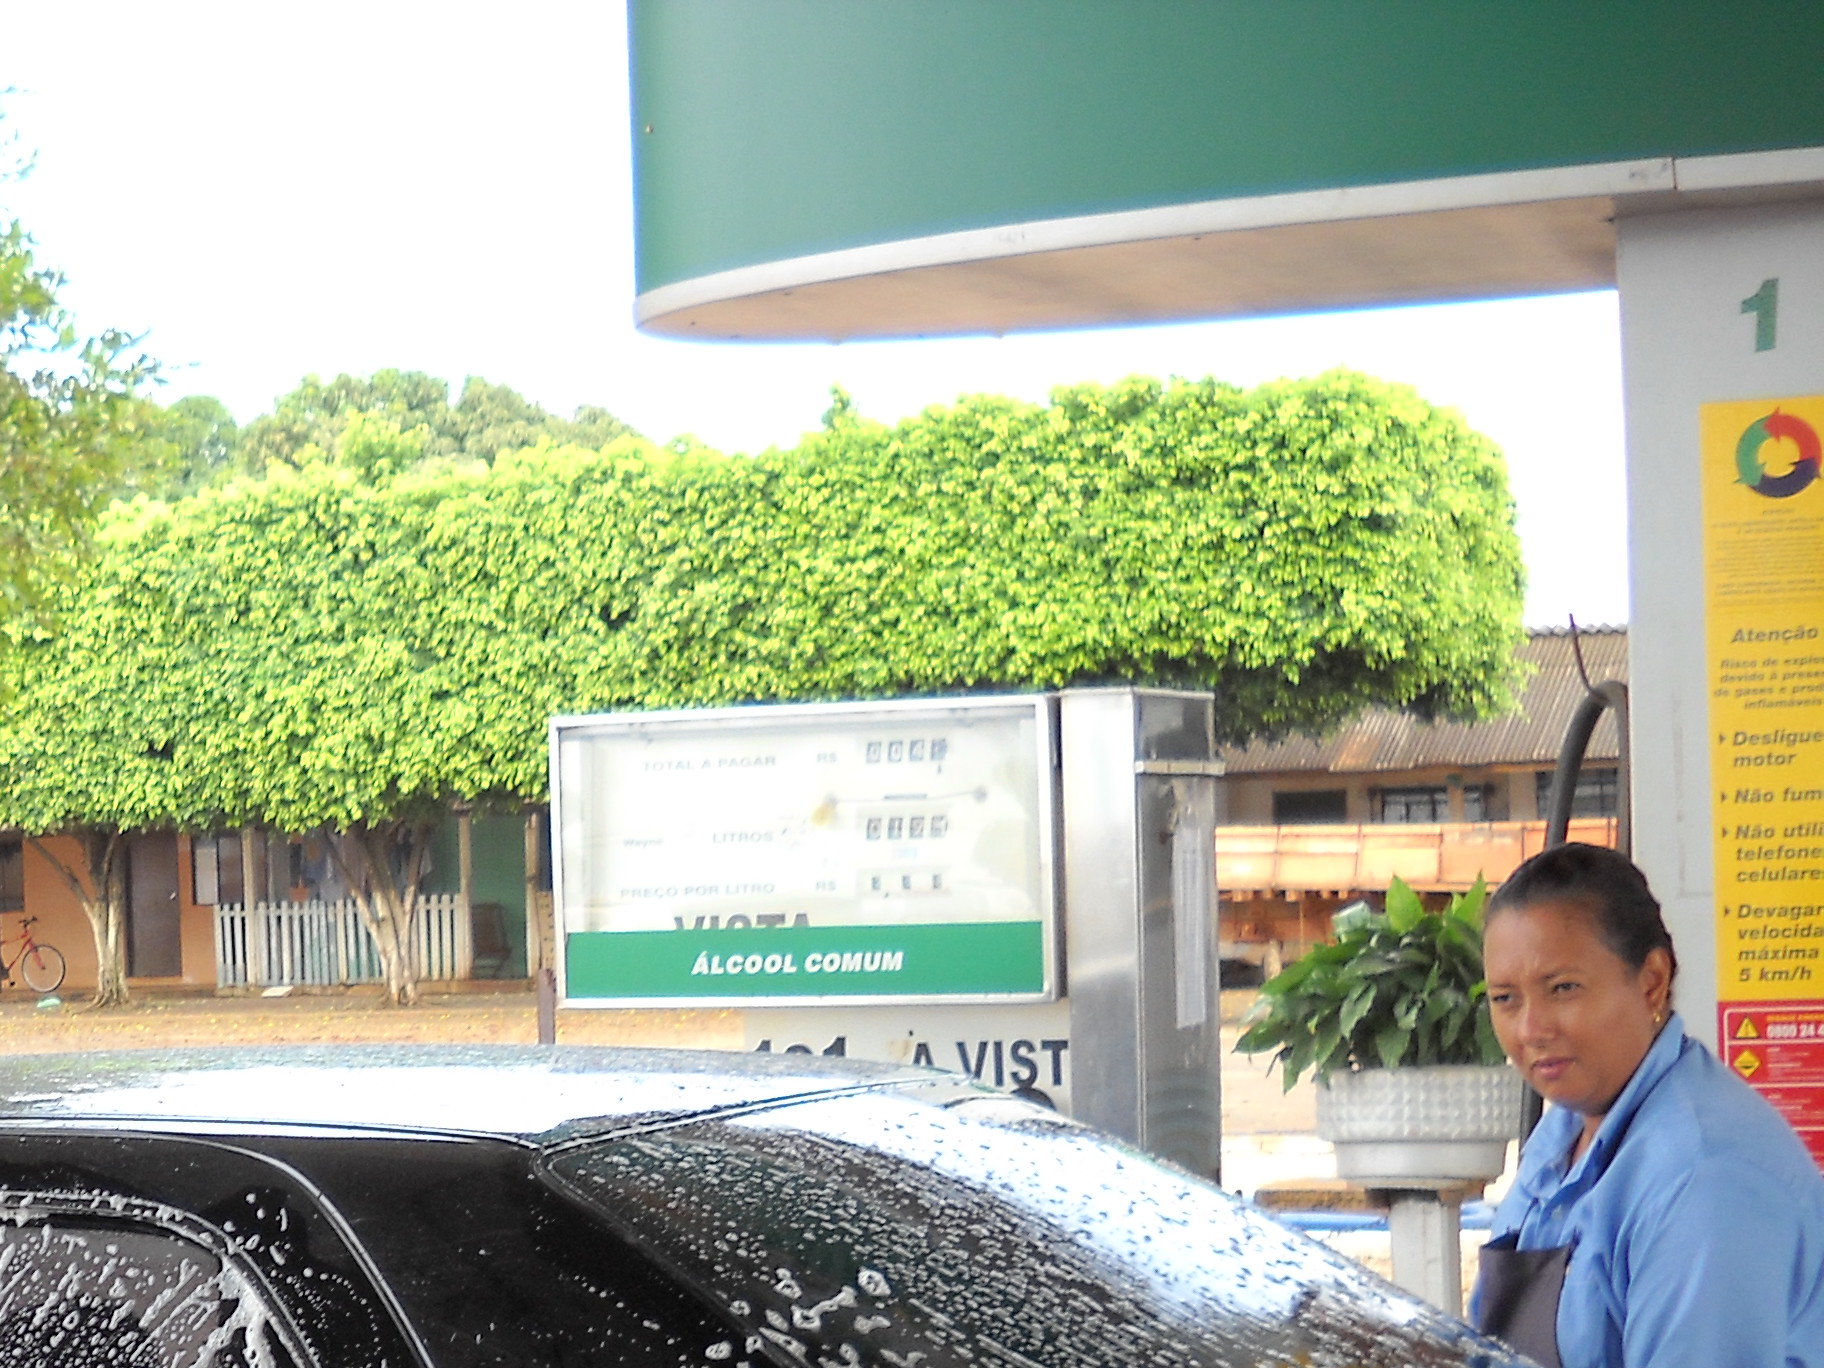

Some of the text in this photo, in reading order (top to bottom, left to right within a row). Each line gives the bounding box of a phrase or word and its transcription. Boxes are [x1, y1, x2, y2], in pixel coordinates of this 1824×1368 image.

[1741, 277, 1779, 352] 1
[1730, 624, 1819, 644] Atenção
[1782, 670, 1824, 681] prese
[1732, 729, 1824, 747] Desligue
[642, 759, 695, 773] TOTAL
[701, 758, 713, 770] A
[718, 755, 777, 768] PAGAR
[1733, 752, 1797, 768] motor
[1734, 786, 1824, 804] Não fum
[712, 831, 775, 845] LITROS
[1735, 823, 1776, 840] Não
[1736, 844, 1824, 862] telefone
[1736, 865, 1824, 883] celulare
[620, 886, 679, 900] PREÇO
[684, 884, 721, 897] POR
[725, 882, 776, 896] LITRO
[1737, 903, 1824, 920] Devagar
[1738, 945, 1820, 961] máxima
[691, 951, 904, 976] ÁLCOOL COMUM
[1739, 965, 1812, 982] 5 km/h
